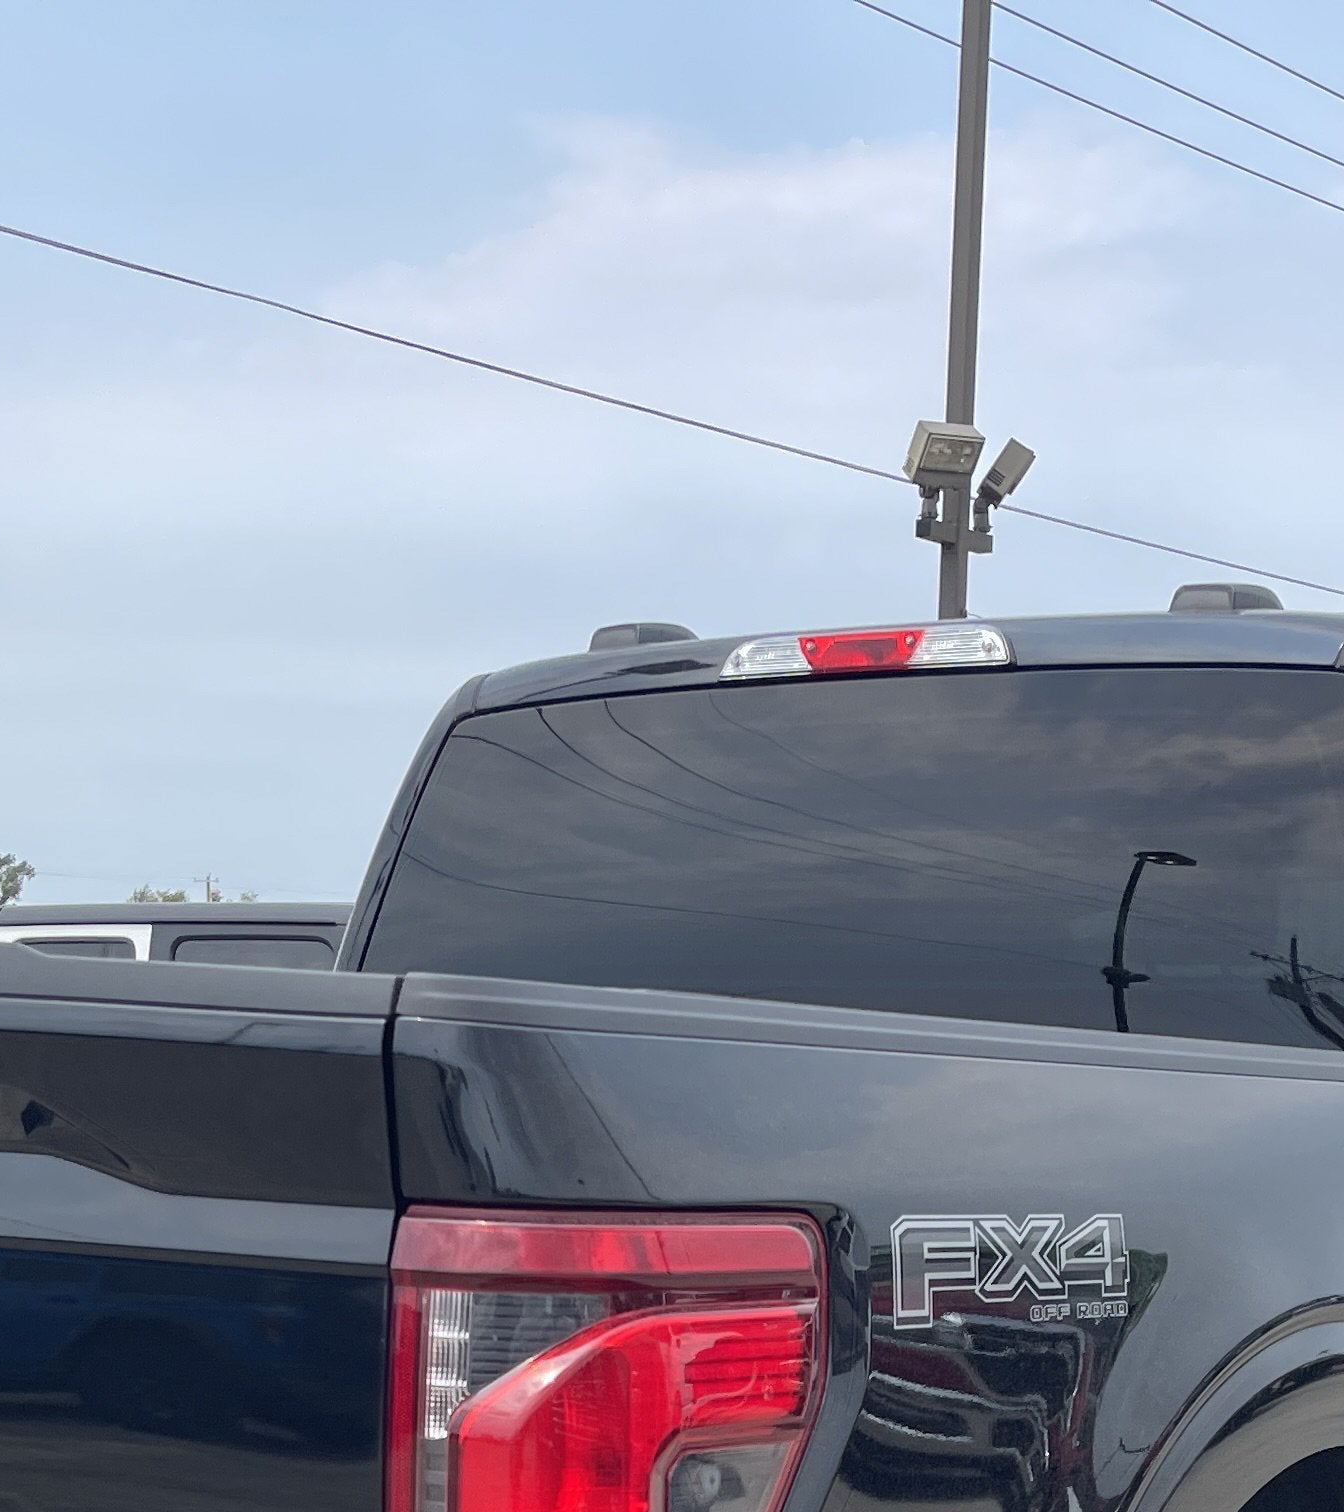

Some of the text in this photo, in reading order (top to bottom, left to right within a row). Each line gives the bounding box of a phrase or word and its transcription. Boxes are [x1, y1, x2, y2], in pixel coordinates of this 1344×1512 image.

[889, 1213, 1131, 1330] FX4
[1029, 1299, 1130, 1322] OFF ROAD
